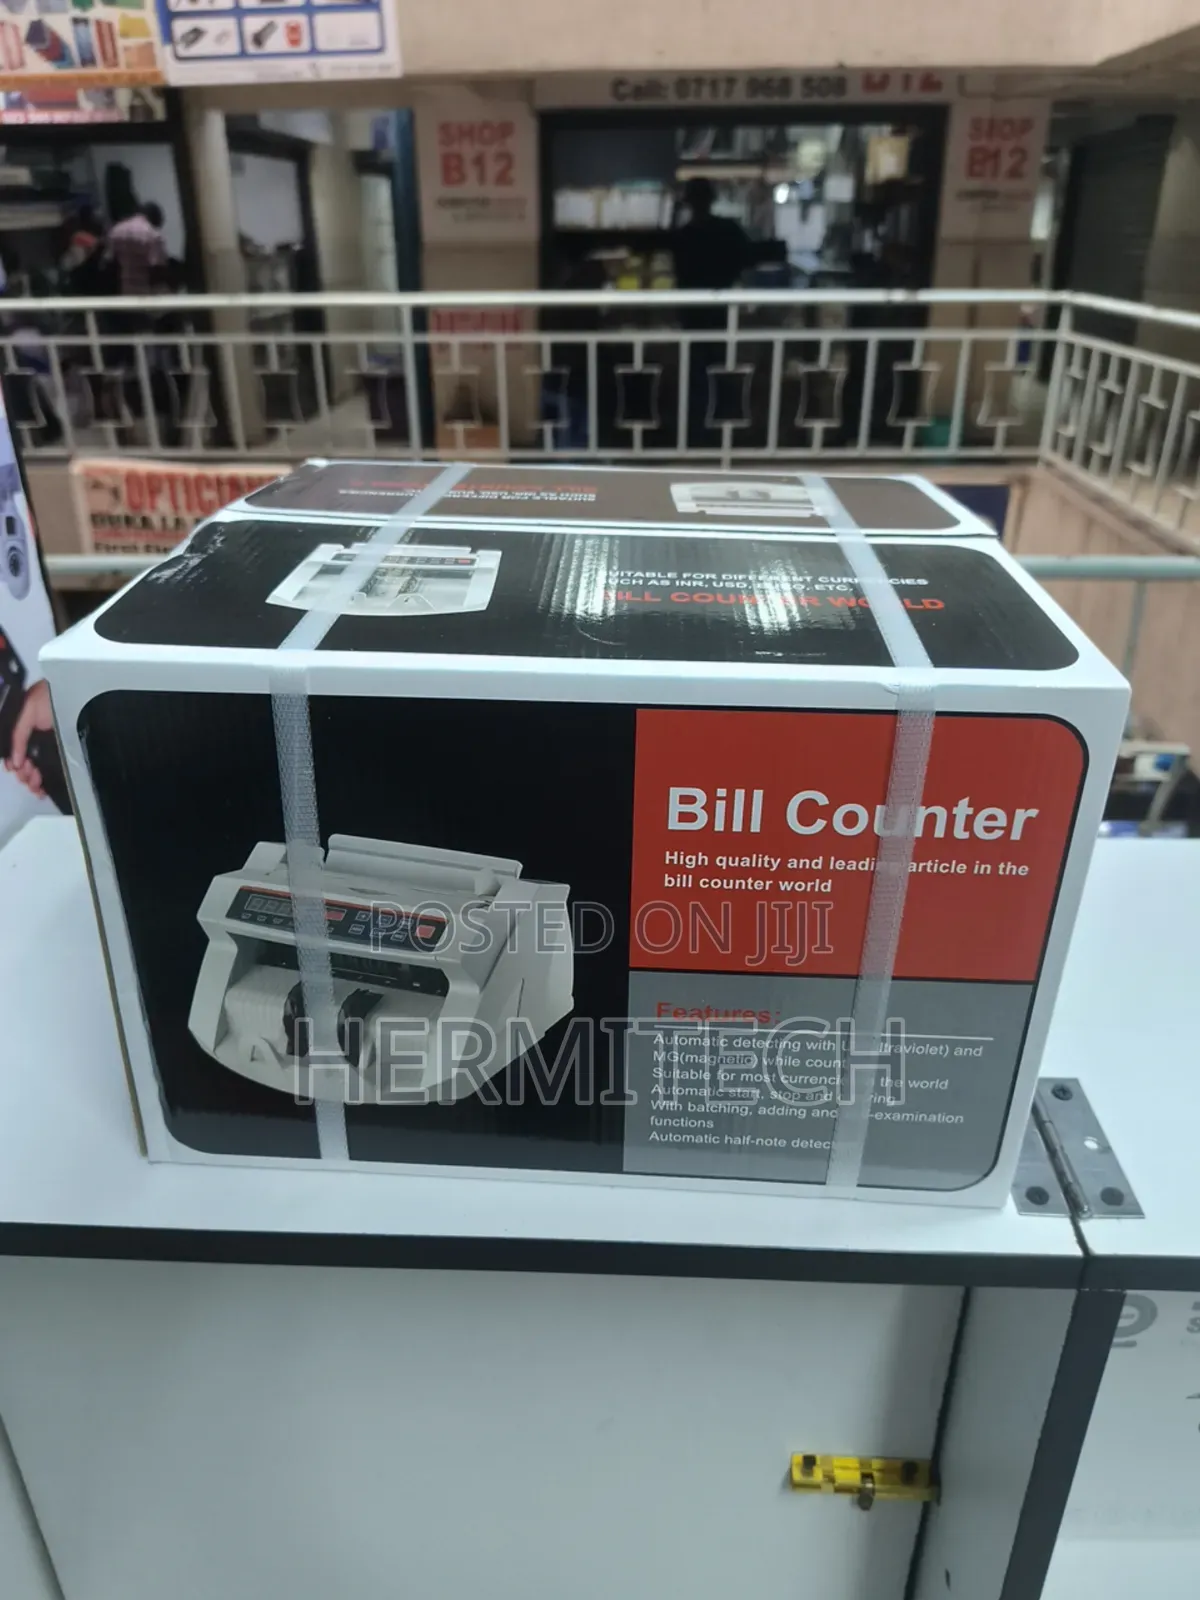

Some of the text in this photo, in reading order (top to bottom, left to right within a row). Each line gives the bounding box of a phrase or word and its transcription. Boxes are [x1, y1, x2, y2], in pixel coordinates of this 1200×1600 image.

[610, 77, 668, 100] Call:
[674, 76, 738, 99] 0717
[801, 75, 847, 98] 508
[438, 121, 515, 147] SHOP
[967, 117, 1034, 142] SHOP
[441, 152, 515, 187] B12
[965, 146, 1029, 180] B12
[647, 579, 671, 587] AS
[681, 572, 709, 580] FOR
[667, 786, 1040, 841] Bill Counter
[665, 850, 1029, 876] High quality and leadi article in the
[664, 874, 832, 893] bill counter world
[656, 1002, 781, 1024] Features:
[653, 1033, 729, 1048] Automatic
[733, 1036, 802, 1052] detecting
[806, 1039, 836, 1051] with
[953, 1045, 983, 1057] and
[653, 1051, 759, 1067] MG(magnetic)
[763, 1056, 801, 1068] while
[652, 1067, 711, 1080] Suitable
[716, 1069, 737, 1081] for
[740, 1072, 776, 1083] most
[880, 1076, 904, 1088] the
[908, 1078, 949, 1090] world
[651, 1083, 724, 1097] Automatic
[769, 1088, 802, 1102] stop
[806, 1090, 833, 1101] and
[651, 1100, 684, 1111] With
[688, 1101, 753, 1117] batching,
[757, 1104, 807, 1119] adding
[650, 1117, 714, 1129] functions
[649, 1131, 721, 1144] Automatic
[724, 1134, 787, 1147] half-note
